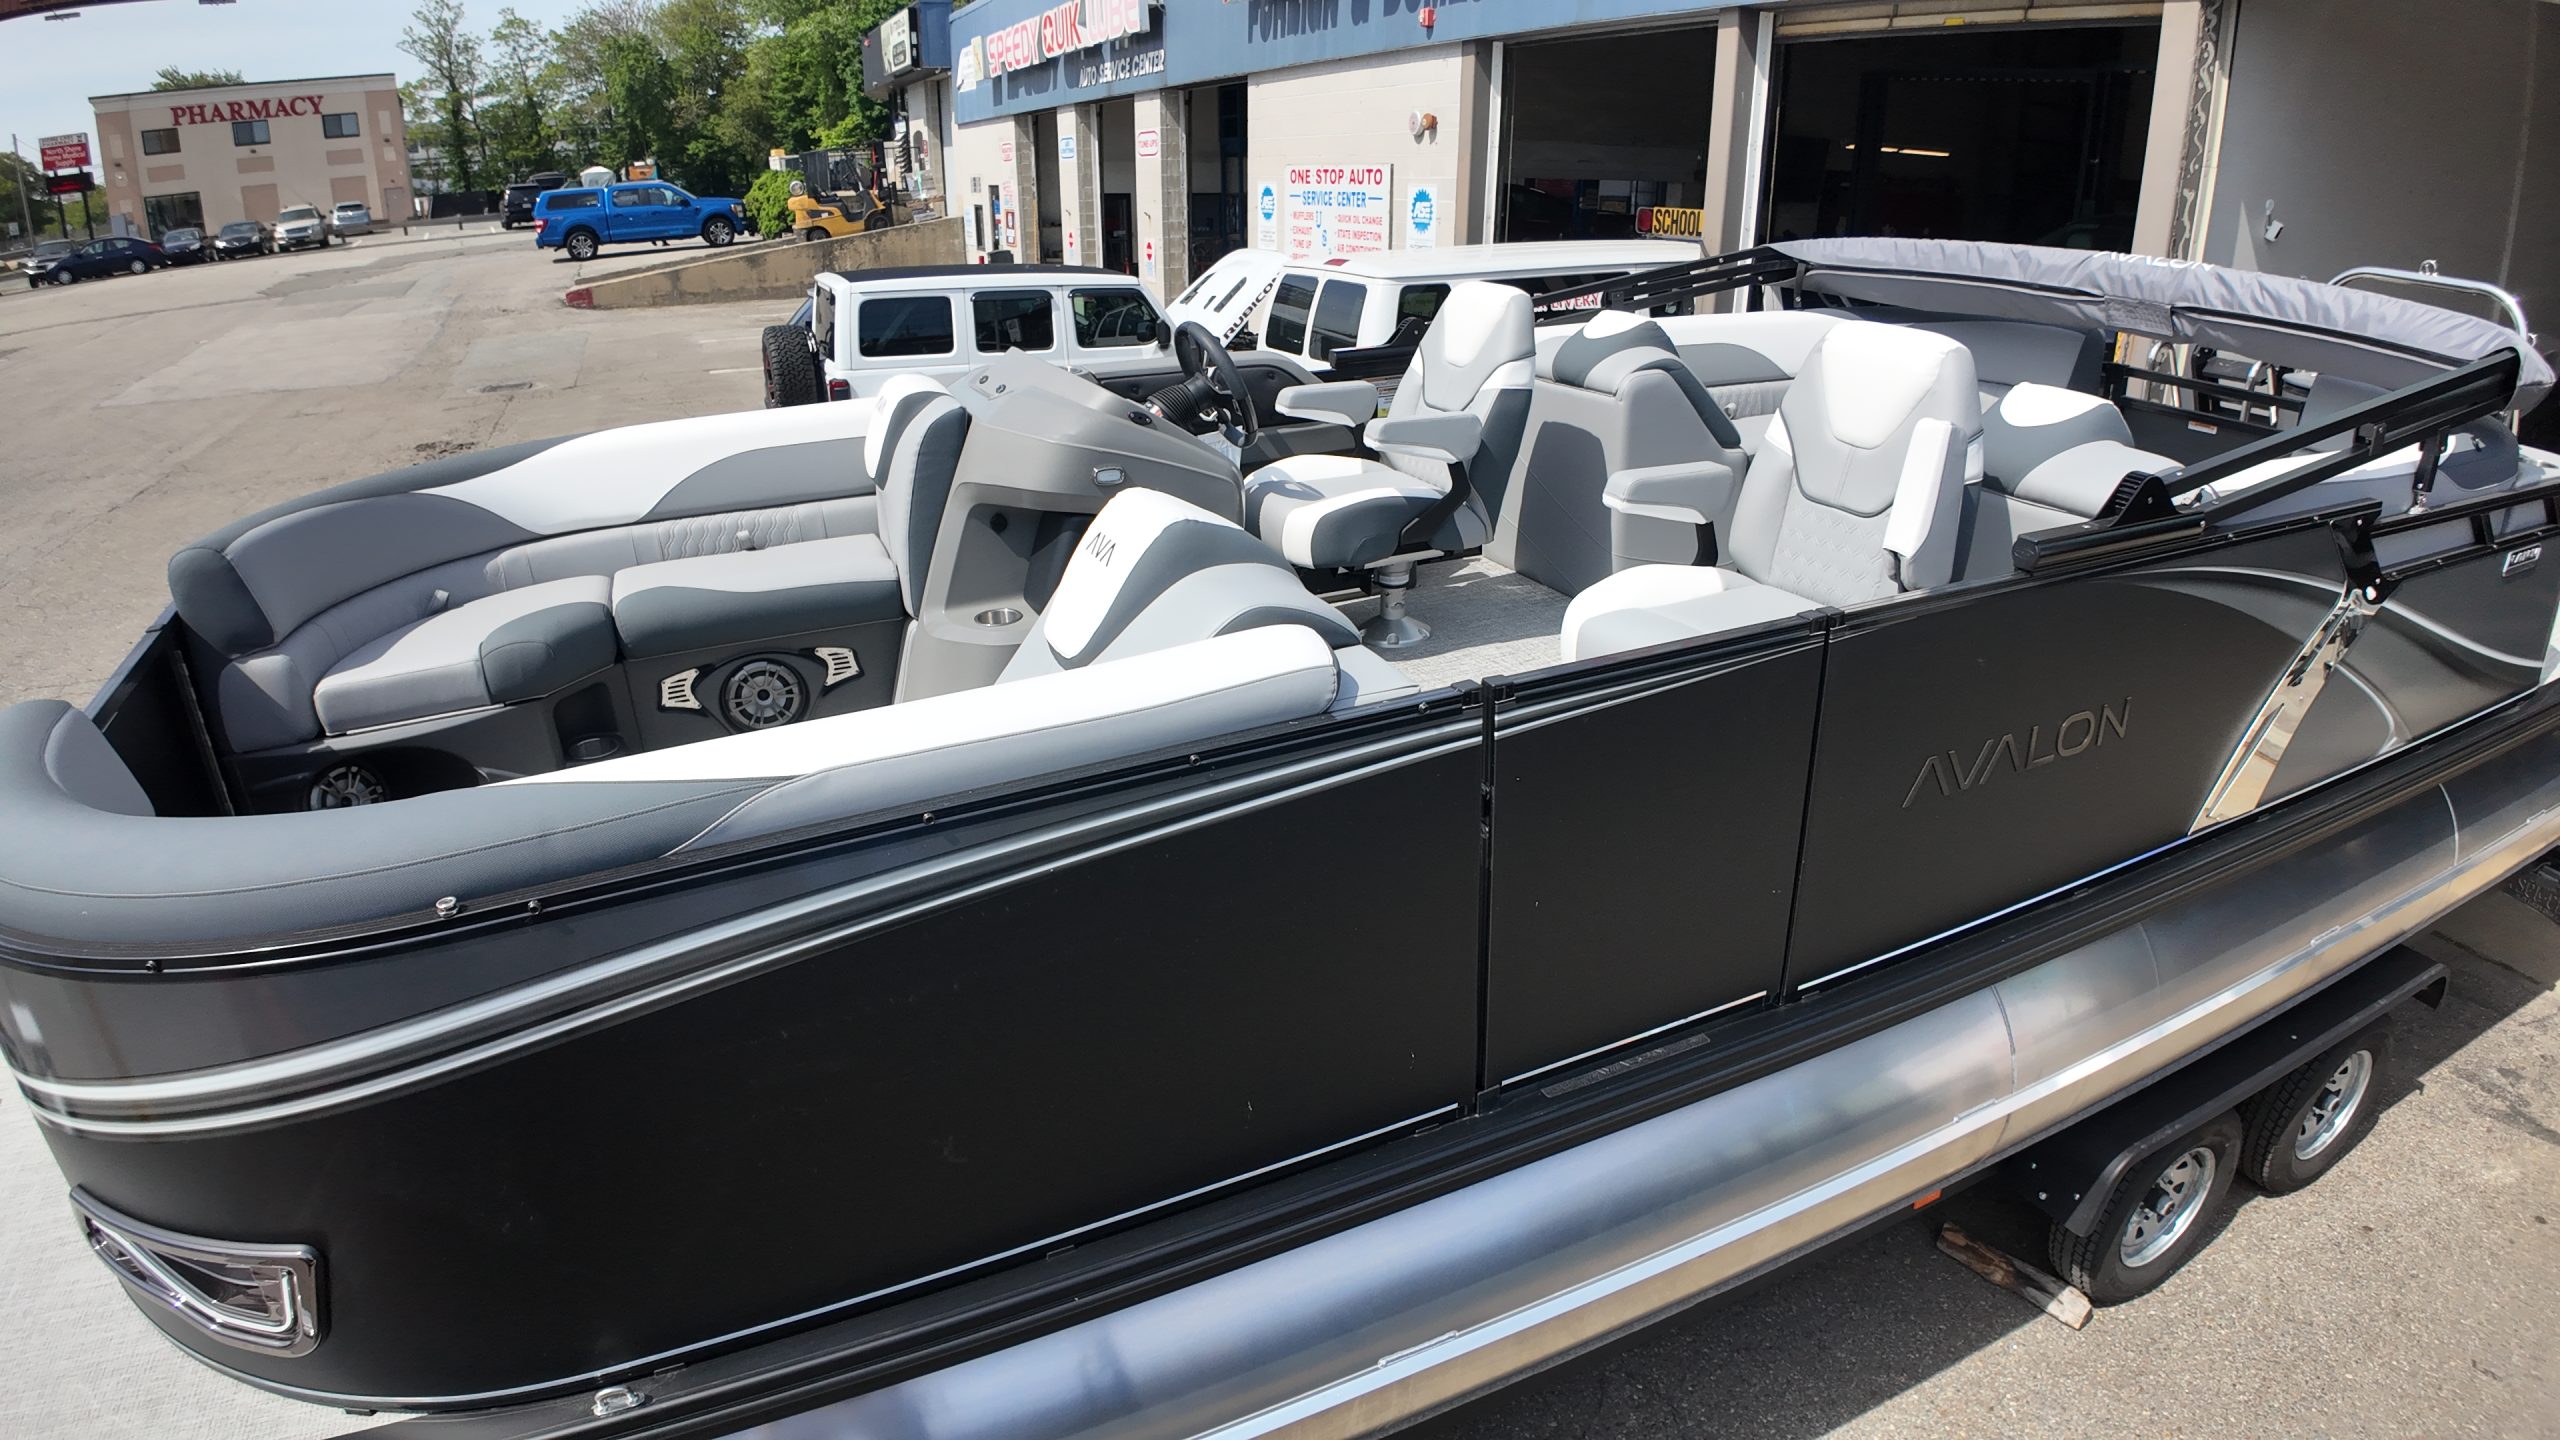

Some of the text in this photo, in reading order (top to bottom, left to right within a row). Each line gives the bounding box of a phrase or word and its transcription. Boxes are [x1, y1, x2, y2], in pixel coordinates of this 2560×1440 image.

[988, 20, 1040, 76] SPEEDY
[1042, 2, 1083, 54] QUIK
[1079, 49, 1165, 88] AUTO SERVICE CENTER
[170, 95, 324, 126] PHARMACY
[1290, 168, 1383, 186] ONE STOP AUTO
[1302, 190, 1366, 208] SERVICE CENTER
[1653, 208, 1702, 237] SCHOOL
[1902, 695, 2133, 809] AVALON
